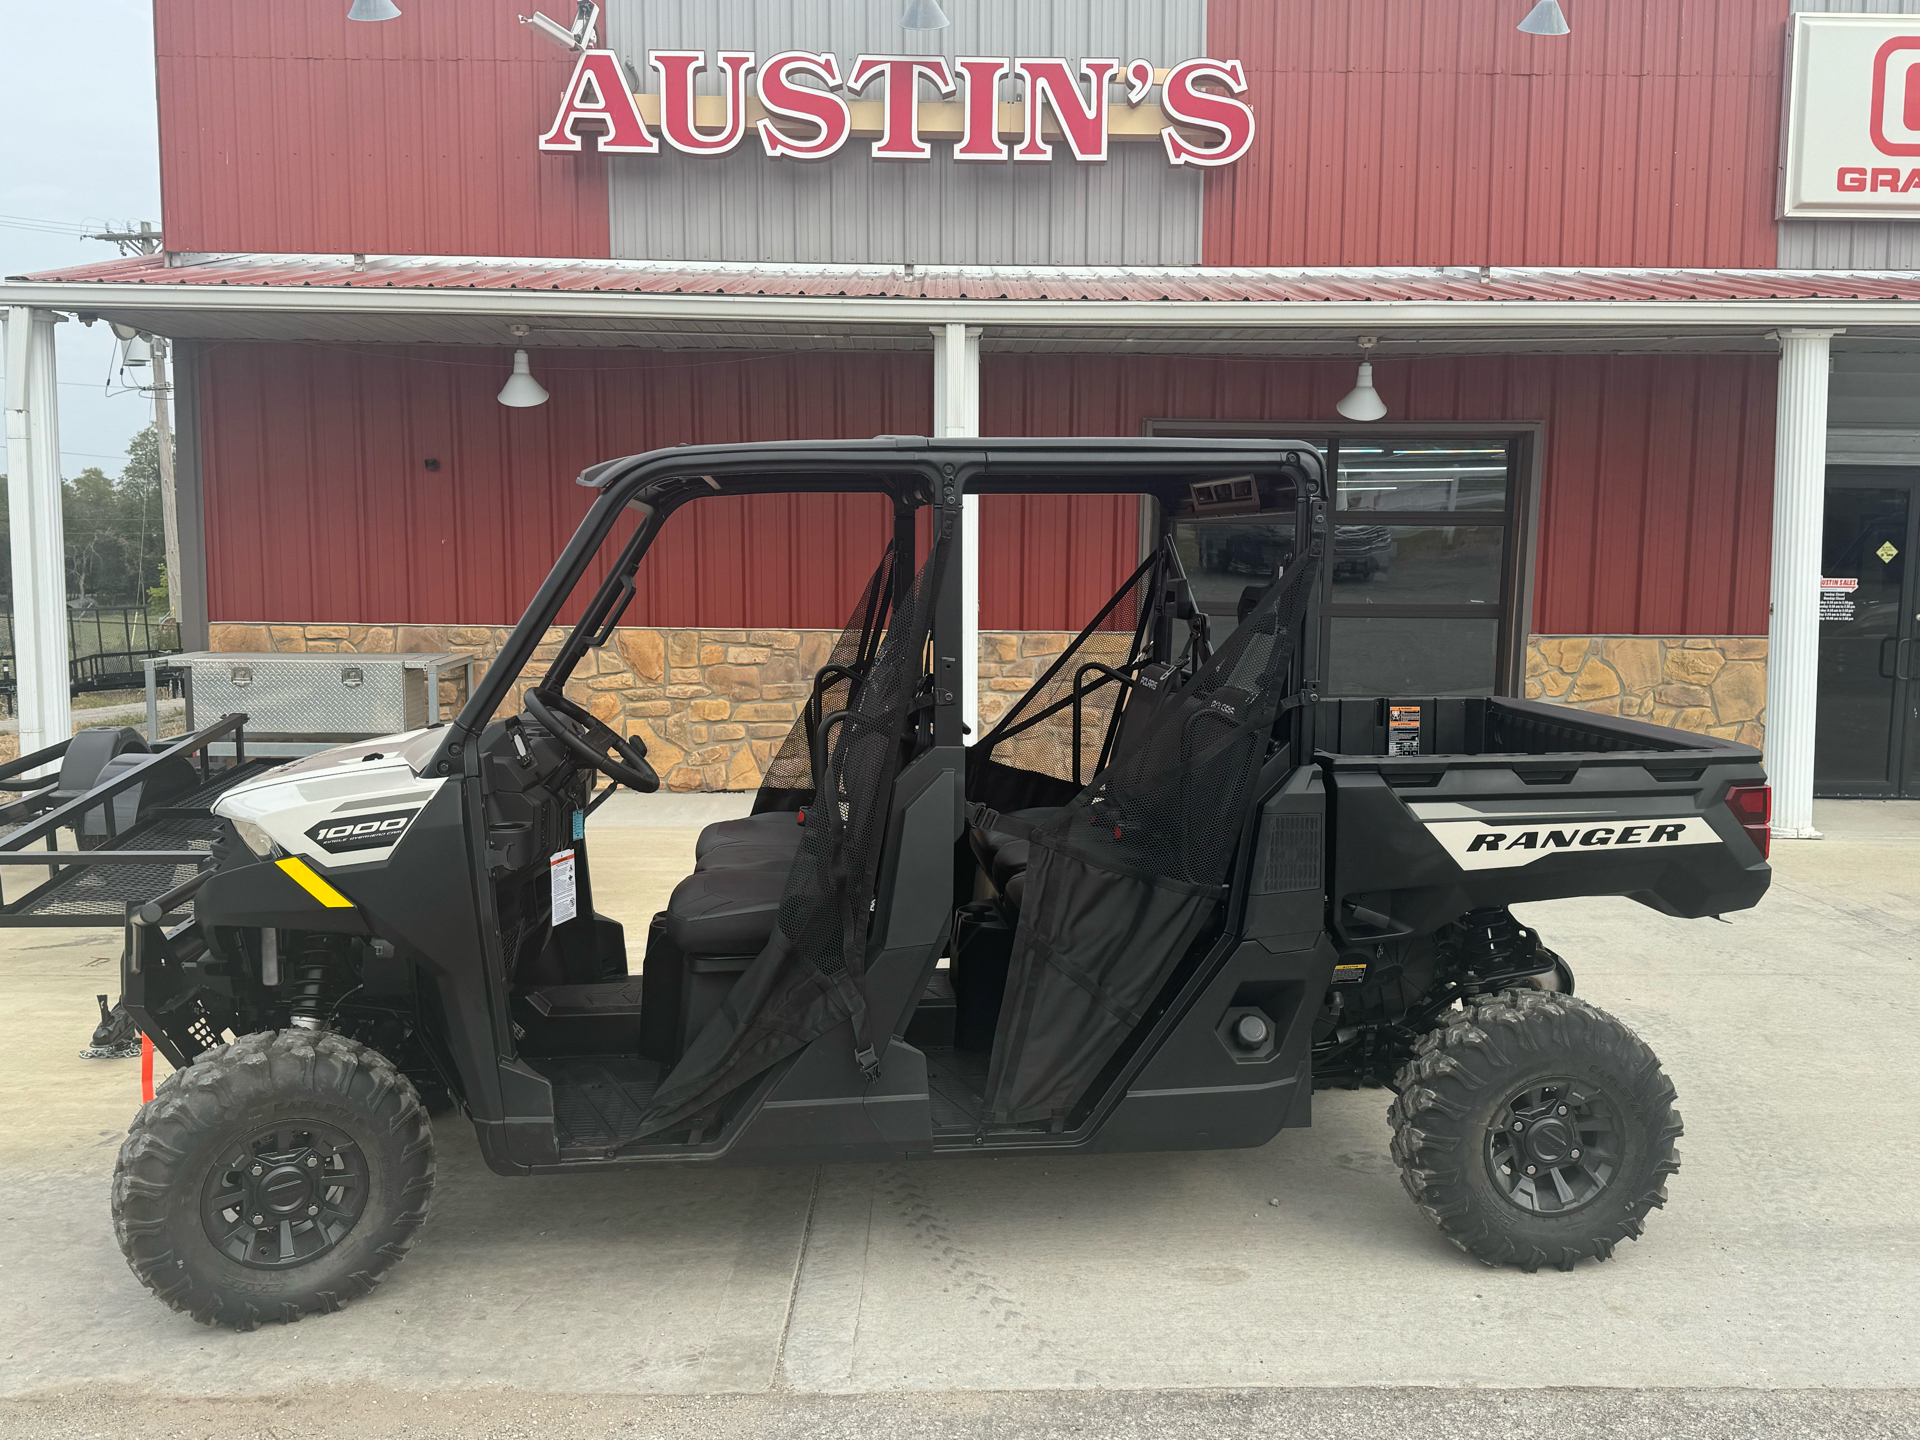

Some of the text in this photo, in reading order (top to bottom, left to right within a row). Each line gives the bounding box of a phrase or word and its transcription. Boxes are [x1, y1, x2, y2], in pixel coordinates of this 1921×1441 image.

[539, 49, 1255, 167] AUSTIN'S
[1140, 676, 1158, 690] POLARIS
[316, 817, 408, 840] 1000
[1466, 823, 1687, 852] RANGER
[1588, 1064, 1644, 1121] CARLSTAR
